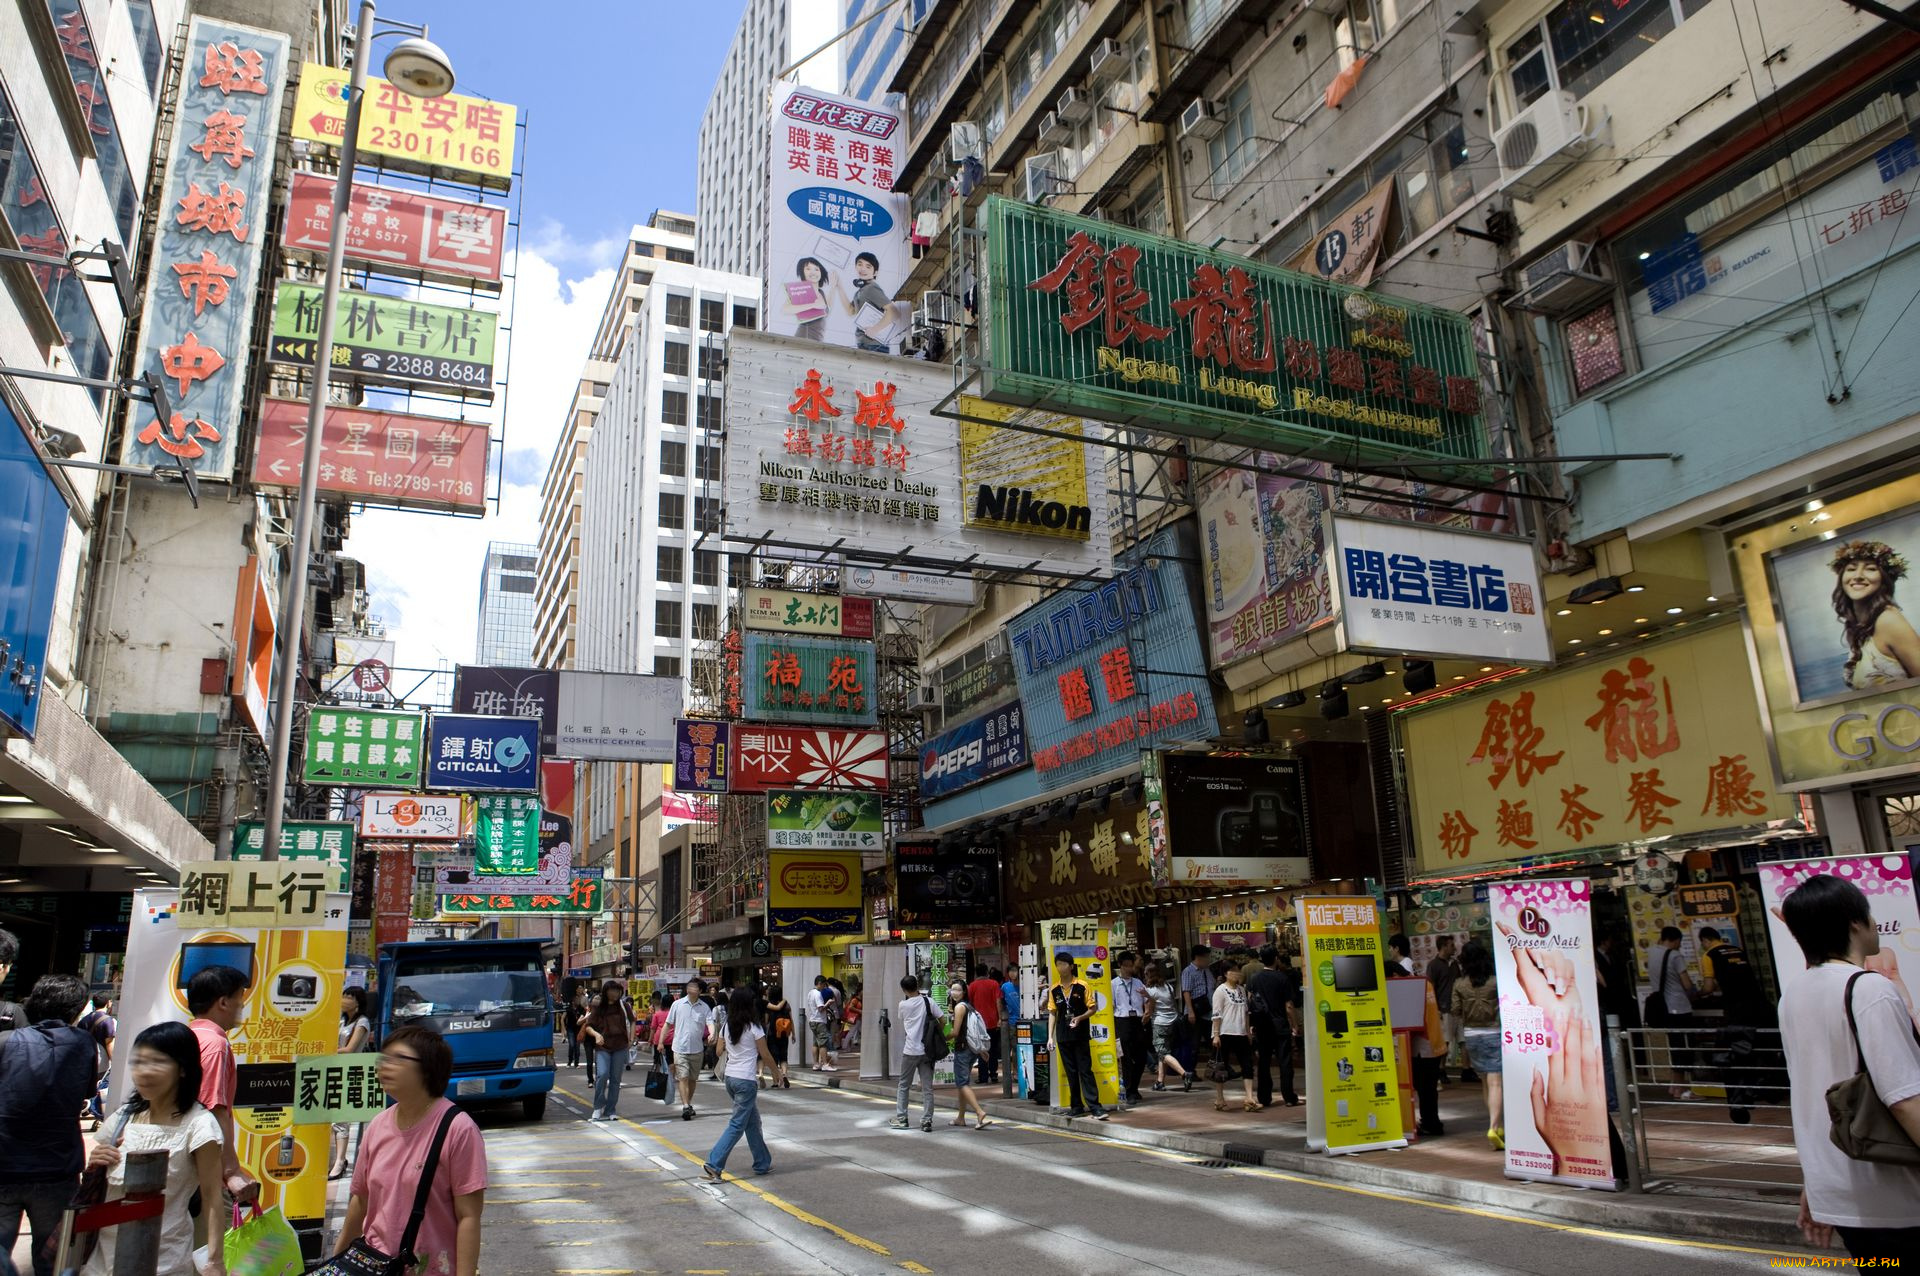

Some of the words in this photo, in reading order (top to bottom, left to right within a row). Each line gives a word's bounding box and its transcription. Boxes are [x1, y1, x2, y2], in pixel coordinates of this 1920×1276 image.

[376, 83, 503, 143] 平安咭
[787, 97, 893, 138] 現代英語
[369, 126, 501, 168] 23011166
[329, 184, 391, 213] 安
[315, 204, 401, 231] 駕學校
[808, 199, 874, 226] 國際認可
[1820, 188, 1909, 245] 七折起
[304, 218, 328, 231] TEL
[345, 226, 370, 238] 784
[375, 232, 408, 244] 5577
[438, 210, 494, 259] 學
[1026, 230, 1279, 373] 銀龍
[311, 344, 351, 367] 樓
[386, 354, 434, 375] 2388
[439, 359, 486, 384] 8684
[1097, 346, 1181, 385] Ngan
[1200, 367, 1279, 408] Lung
[1292, 385, 1444, 440] Restaurant
[297, 461, 358, 486] 字樓
[760, 461, 803, 480] Nikon
[809, 467, 888, 491] Authorized
[894, 477, 939, 497] Dealer
[976, 483, 1091, 533] Nikon
[1012, 565, 1159, 677] TAMRON
[764, 650, 863, 693] 福苑
[318, 714, 414, 741] 學生書屋
[1466, 657, 1682, 790] 銀龍
[441, 736, 493, 760] 鐳射
[741, 734, 791, 753] 美心
[437, 761, 502, 773] CITICALL
[740, 754, 791, 774] MX
[937, 738, 983, 779] PEPSI
[1266, 764, 1294, 774] Canon
[375, 799, 447, 823] Laguna
[1438, 754, 1769, 860] 粉麵茶餐廳
[541, 821, 560, 831] Lee
[900, 847, 934, 855] PENTAX
[180, 871, 325, 916] 網上行
[1100, 881, 1157, 911] PHOTO
[1308, 904, 1375, 926] 和記寬頻
[1876, 920, 1900, 936] ail
[1050, 923, 1097, 941] 網上行
[1315, 938, 1377, 951] 精選數碼禮品
[1548, 934, 1581, 950] Nail
[450, 1020, 491, 1030] ISUZU
[250, 1079, 291, 1088] BRAVIA
[300, 1065, 384, 1111] 家居電話
